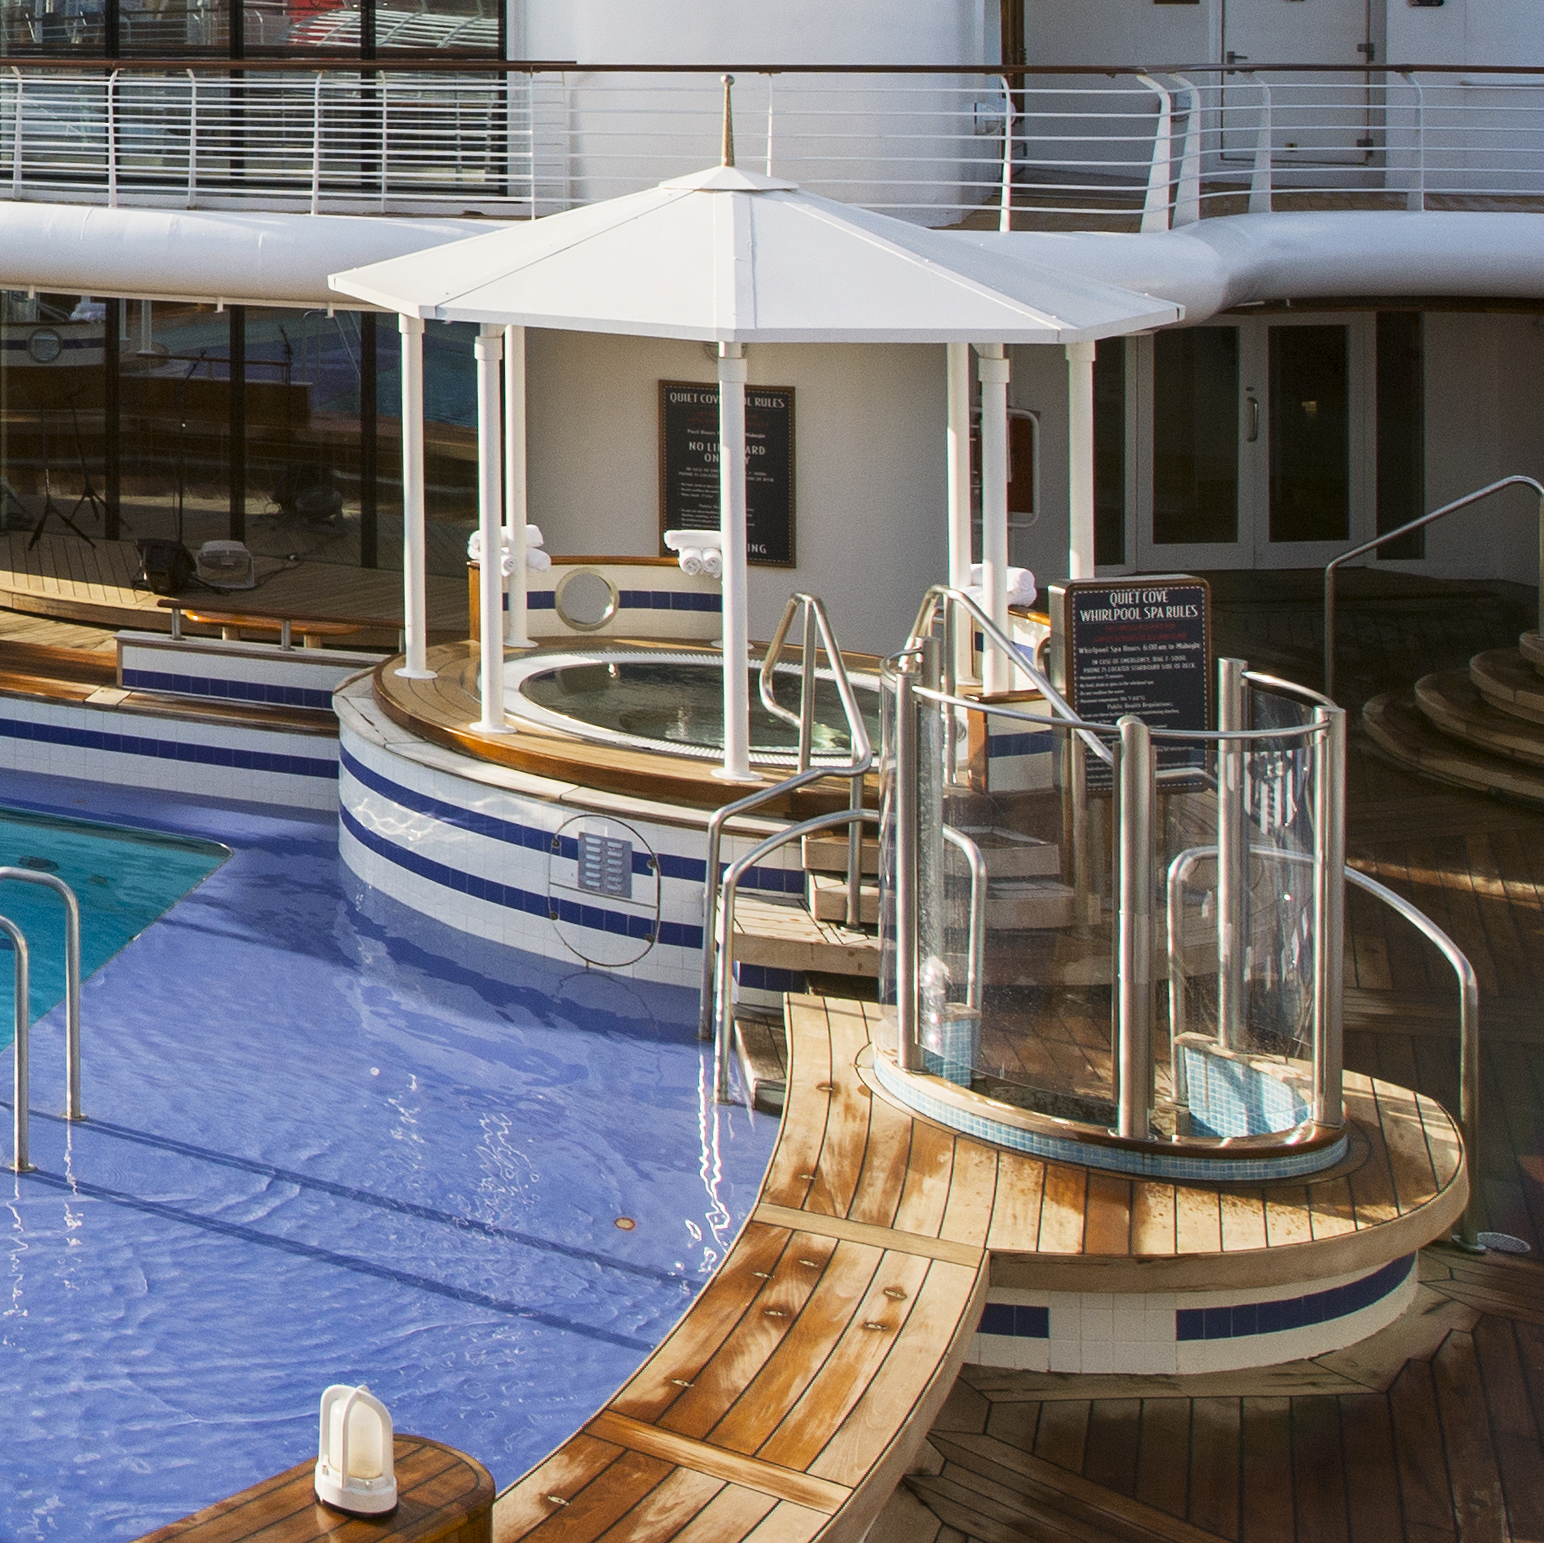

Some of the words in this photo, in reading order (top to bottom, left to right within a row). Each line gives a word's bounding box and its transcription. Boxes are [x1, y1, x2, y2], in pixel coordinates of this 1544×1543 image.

[670, 392, 698, 405] QUIET
[700, 394, 719, 404] COV
[755, 397, 785, 408] RULES
[689, 442, 704, 451] NO
[704, 454, 719, 462] ON
[1109, 592, 1140, 607] QUIET
[1143, 590, 1169, 604] COVE
[1079, 608, 1141, 622] WHIRLPOOL
[1143, 606, 1165, 620] SPA
[1166, 604, 1199, 618] RULES
